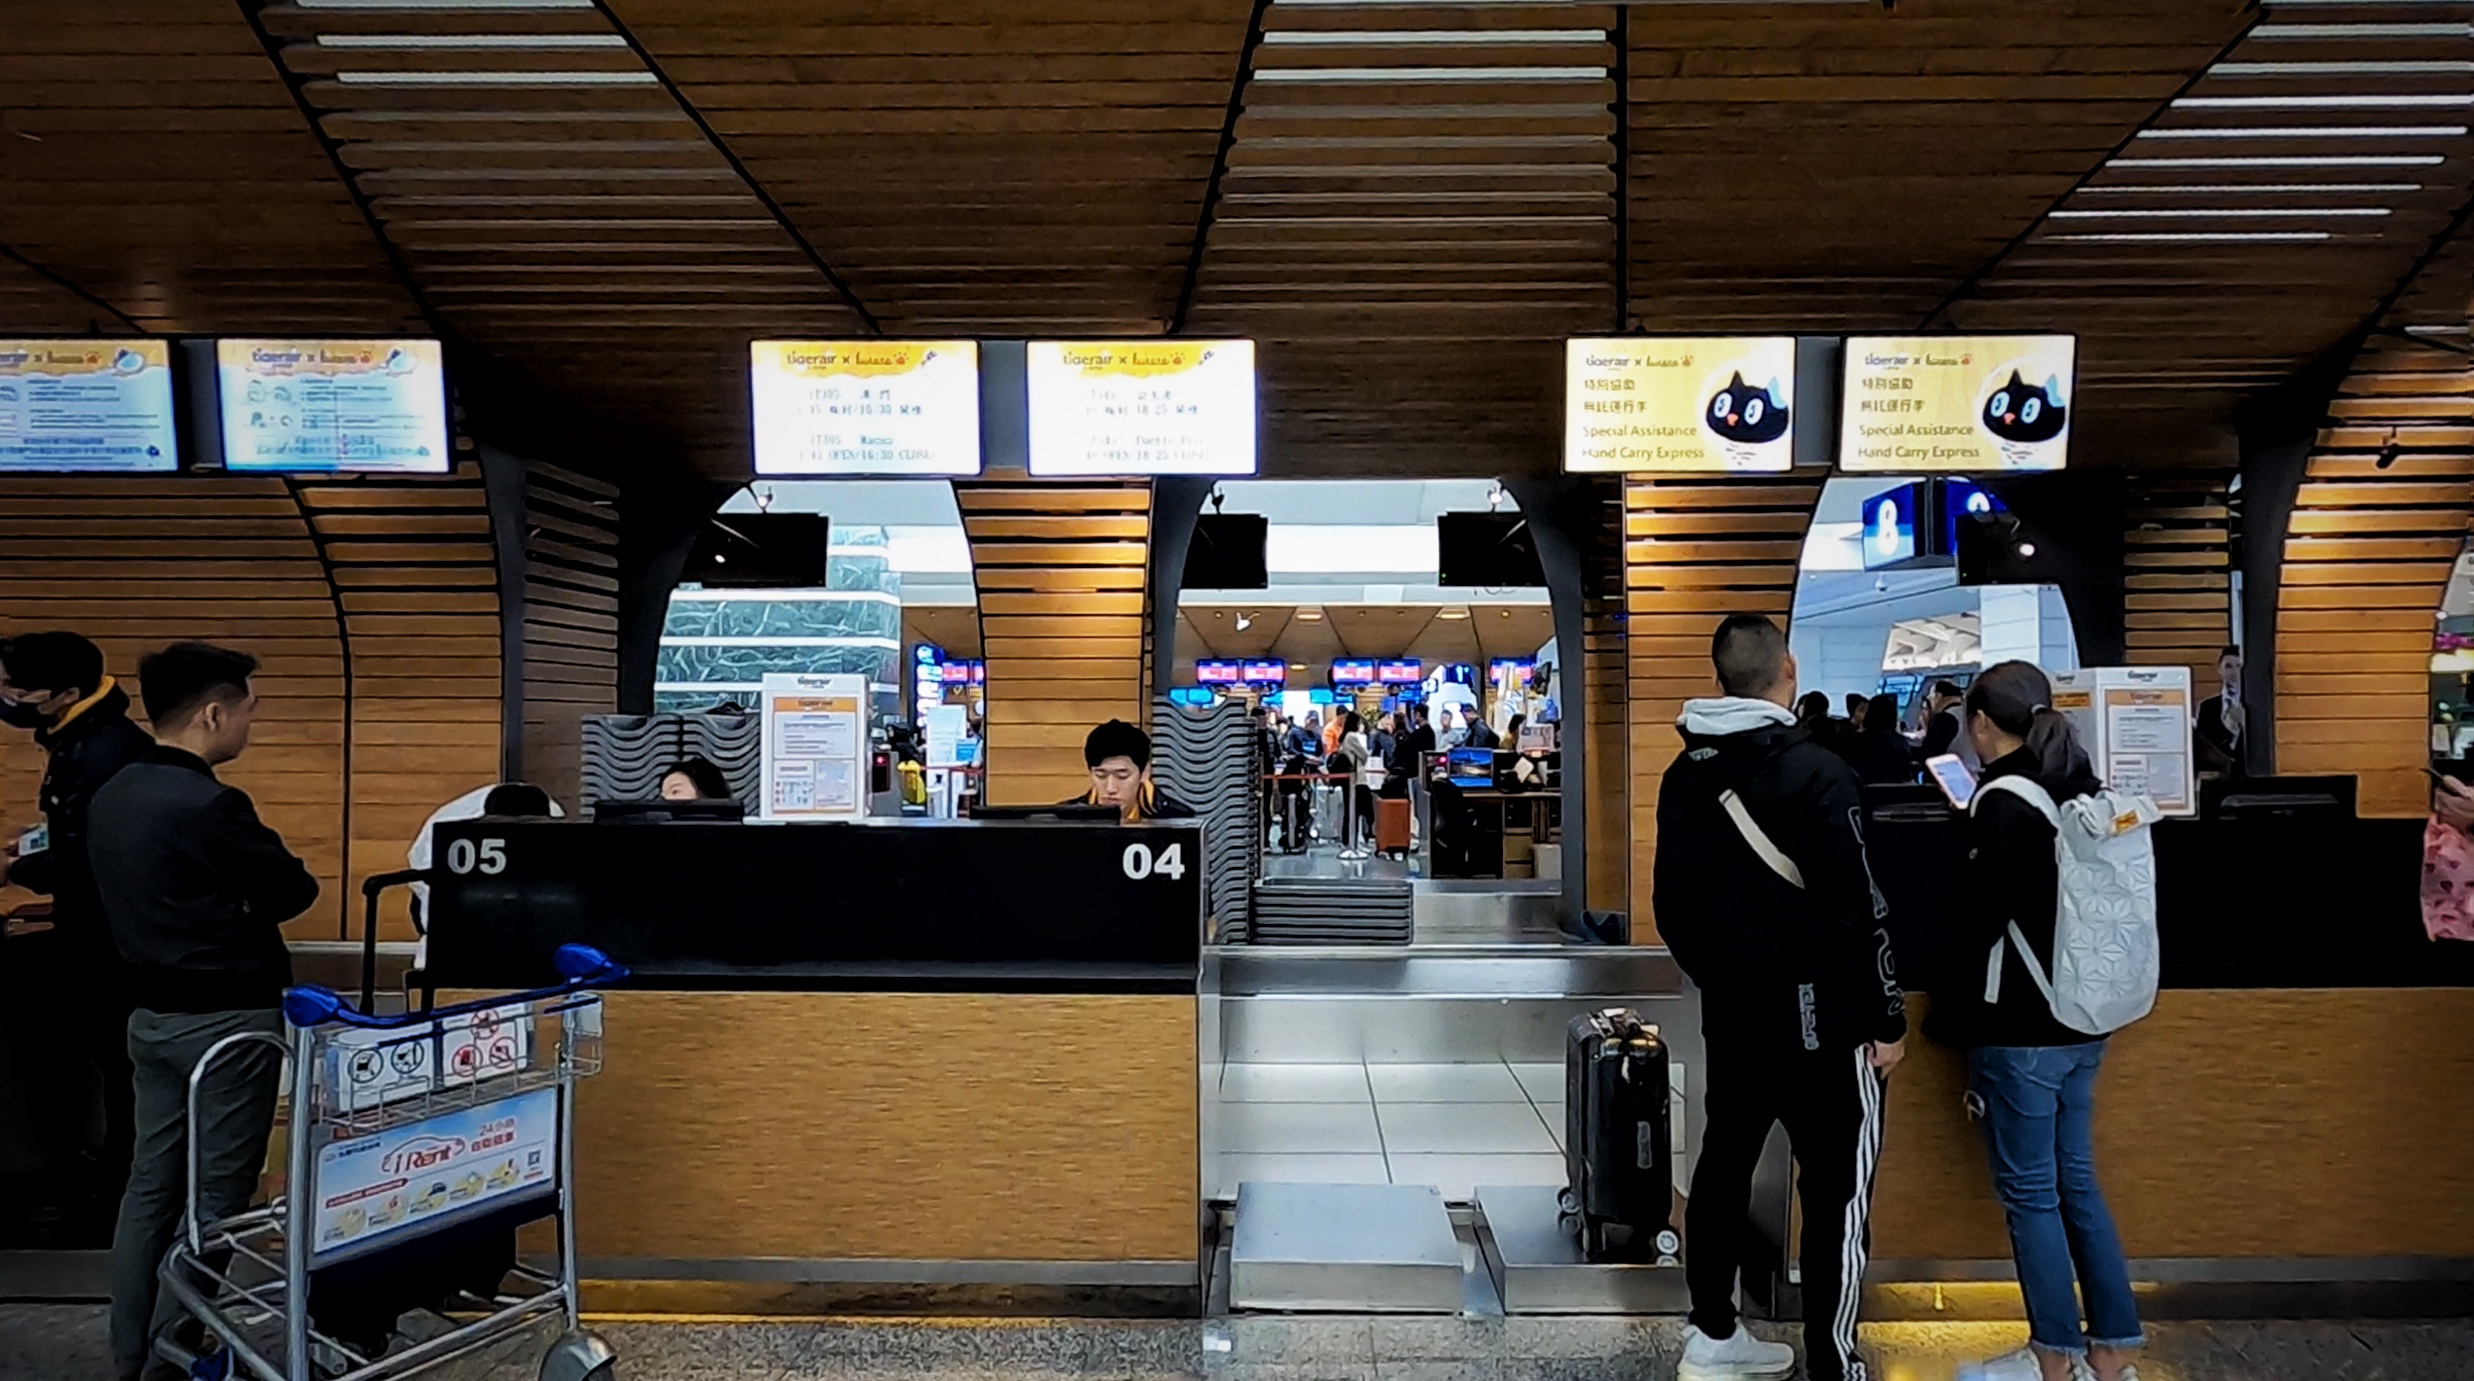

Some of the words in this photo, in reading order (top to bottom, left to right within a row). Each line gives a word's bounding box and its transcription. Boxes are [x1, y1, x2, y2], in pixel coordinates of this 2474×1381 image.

[1583, 425, 1628, 438] Special
[1631, 425, 1697, 437] Assistance
[1860, 424, 1904, 437] Special
[1906, 424, 1974, 437] Assistance
[1582, 447, 1617, 458] Hand
[1619, 447, 1654, 461] Carry
[1656, 446, 1705, 460] Express
[1858, 447, 1892, 458] Hand
[1895, 447, 1929, 461] Carry
[1933, 446, 1980, 460] Express
[1877, 499, 1899, 556] 8
[447, 838, 507, 875] 05
[1122, 843, 1186, 880] 04
